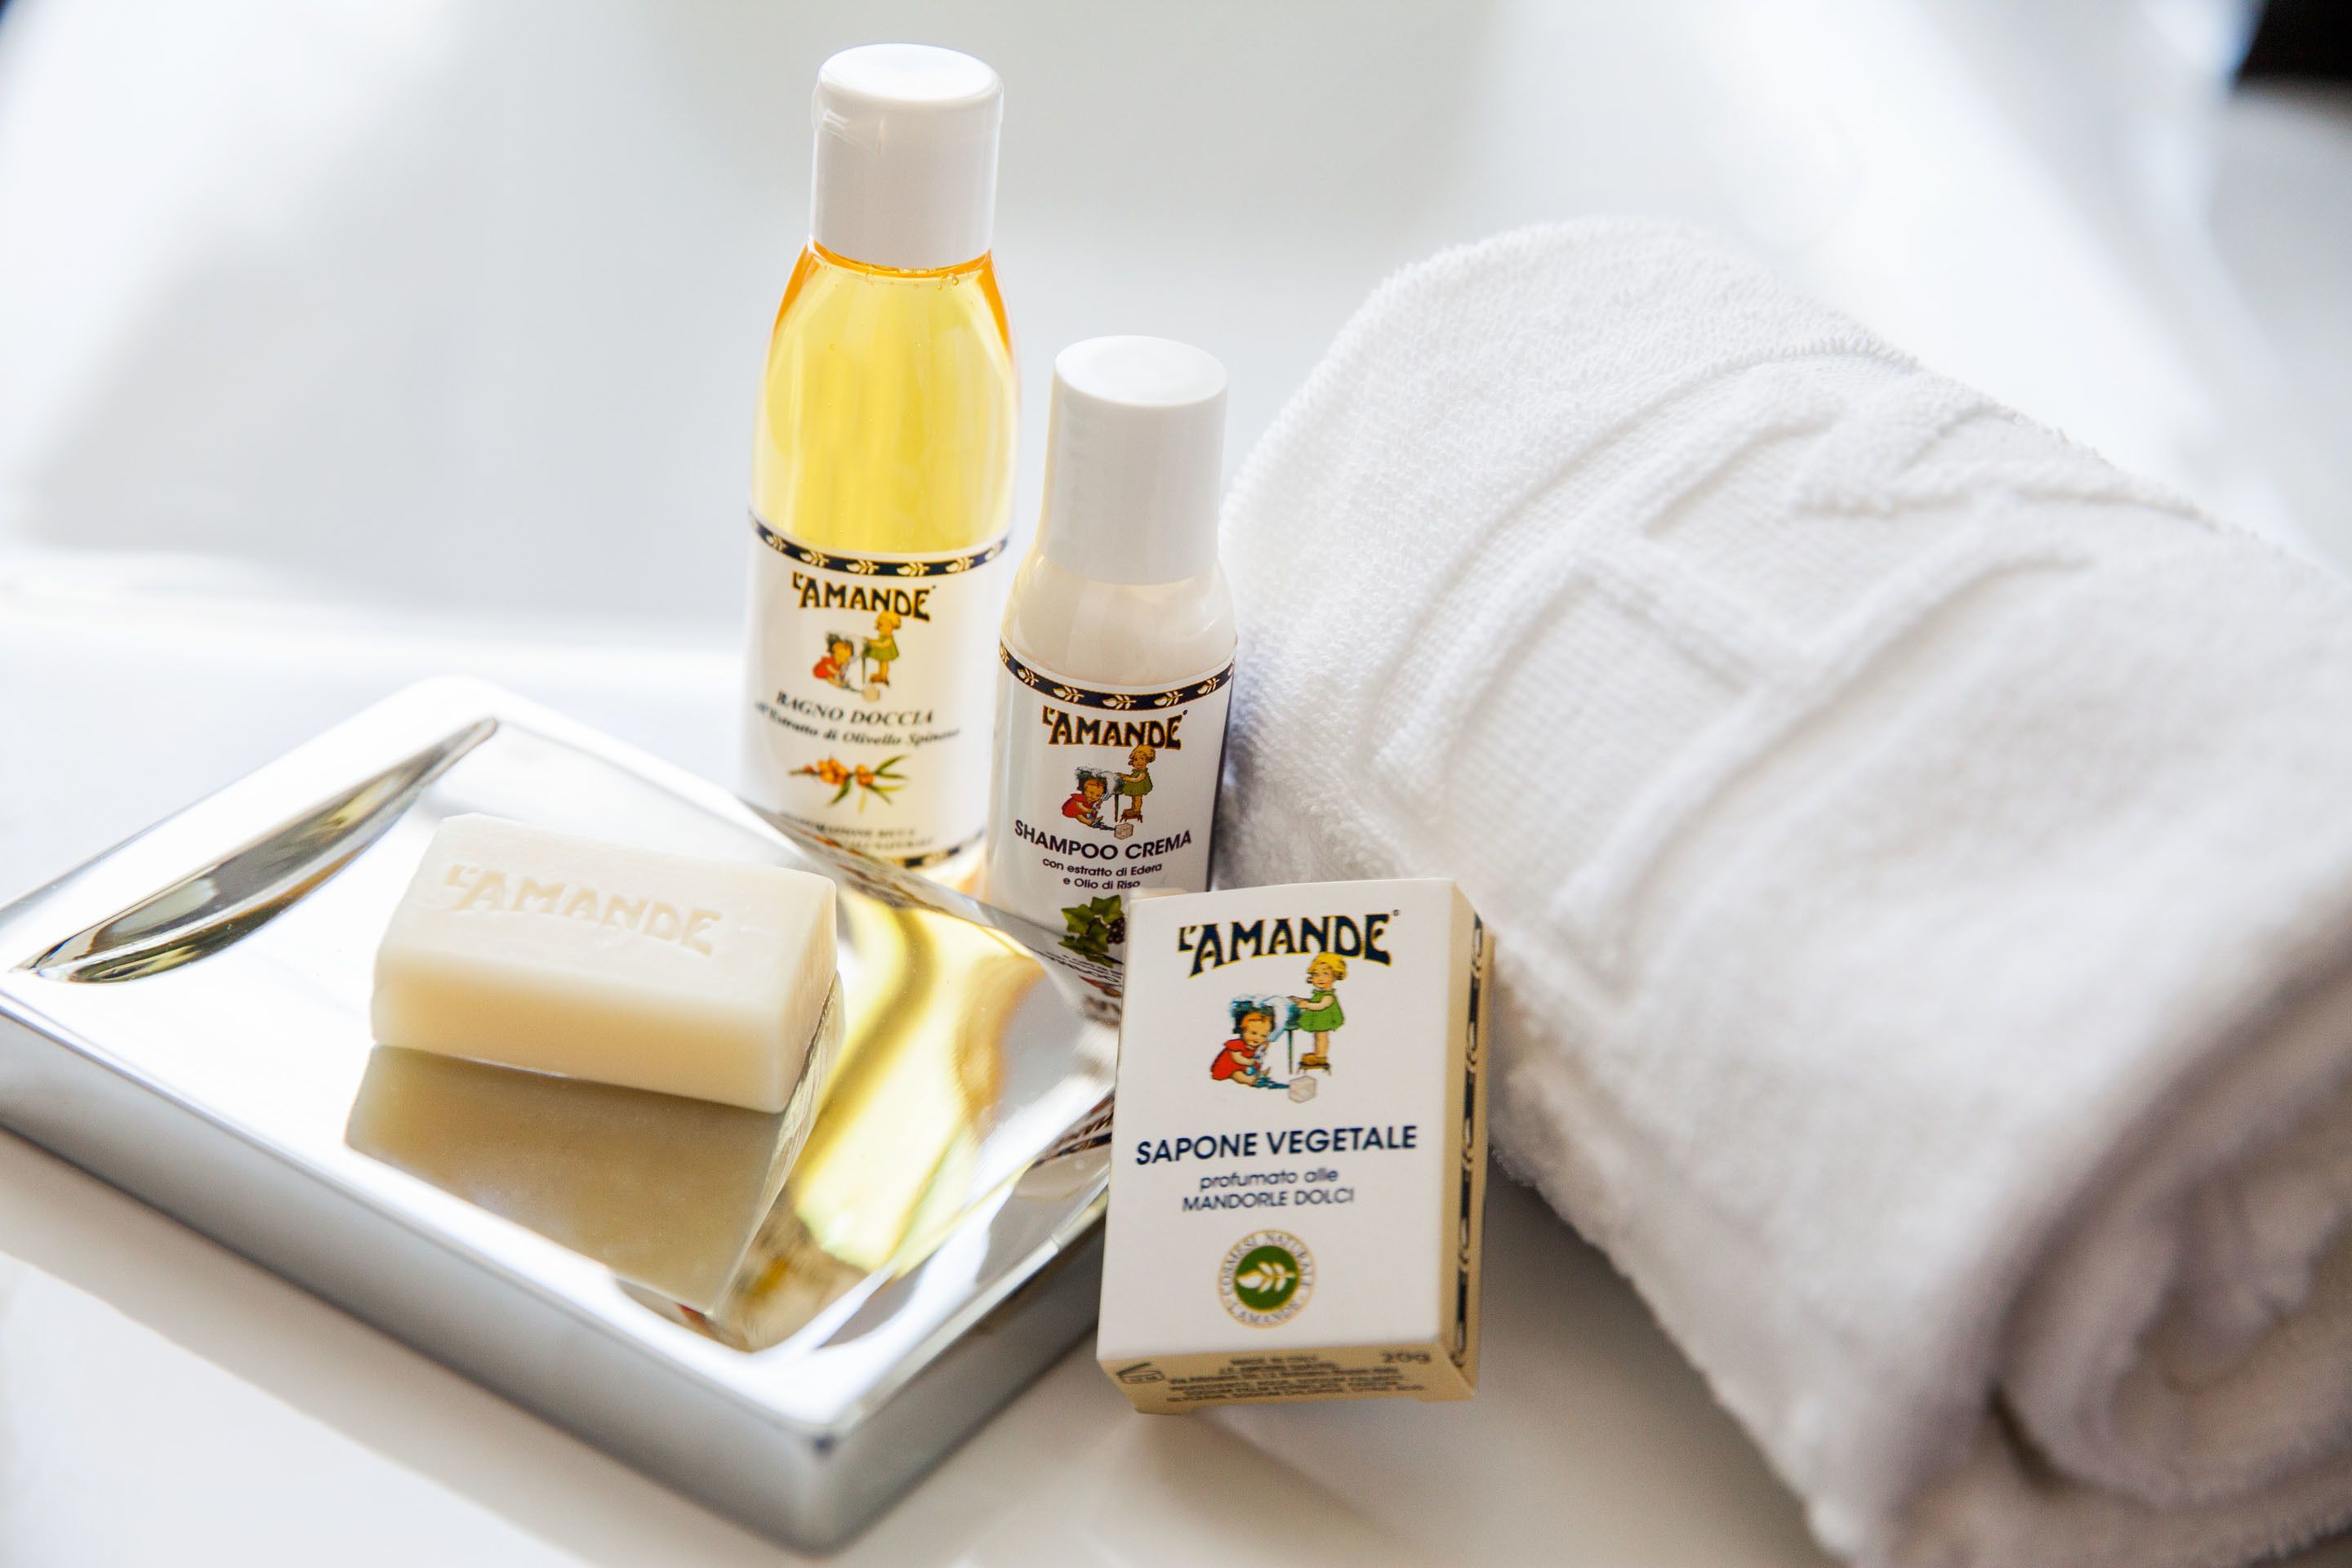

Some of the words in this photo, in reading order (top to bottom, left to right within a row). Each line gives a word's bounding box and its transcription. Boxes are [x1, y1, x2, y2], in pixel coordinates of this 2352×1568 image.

[791, 570, 931, 622] L'AMANDE
[850, 709, 933, 726] DOCCIA
[1041, 705, 1184, 751] L'AMANDE
[822, 728, 837, 741] di
[1014, 819, 1119, 860] SHAMPOO
[1125, 830, 1192, 859] CREMA
[1042, 858, 1064, 871] con
[1067, 864, 1112, 877] estratto
[1116, 866, 1128, 877] di
[1130, 863, 1163, 876] Edera
[1062, 877, 1071, 885] e
[1074, 878, 1098, 889] Olio
[1102, 880, 1114, 889] di
[1116, 880, 1140, 890] Riso
[443, 863, 723, 957] L'AMANDE
[1178, 913, 1393, 978] L'AMANDE
[1136, 1132, 1258, 1165] SAPONE
[1265, 1125, 1418, 1156] VEGETALE
[1200, 1169, 1298, 1192] profumato
[1303, 1168, 1339, 1183] alle
[1182, 1190, 1289, 1212] MANDORLE
[1294, 1187, 1355, 1206] DOLCI
